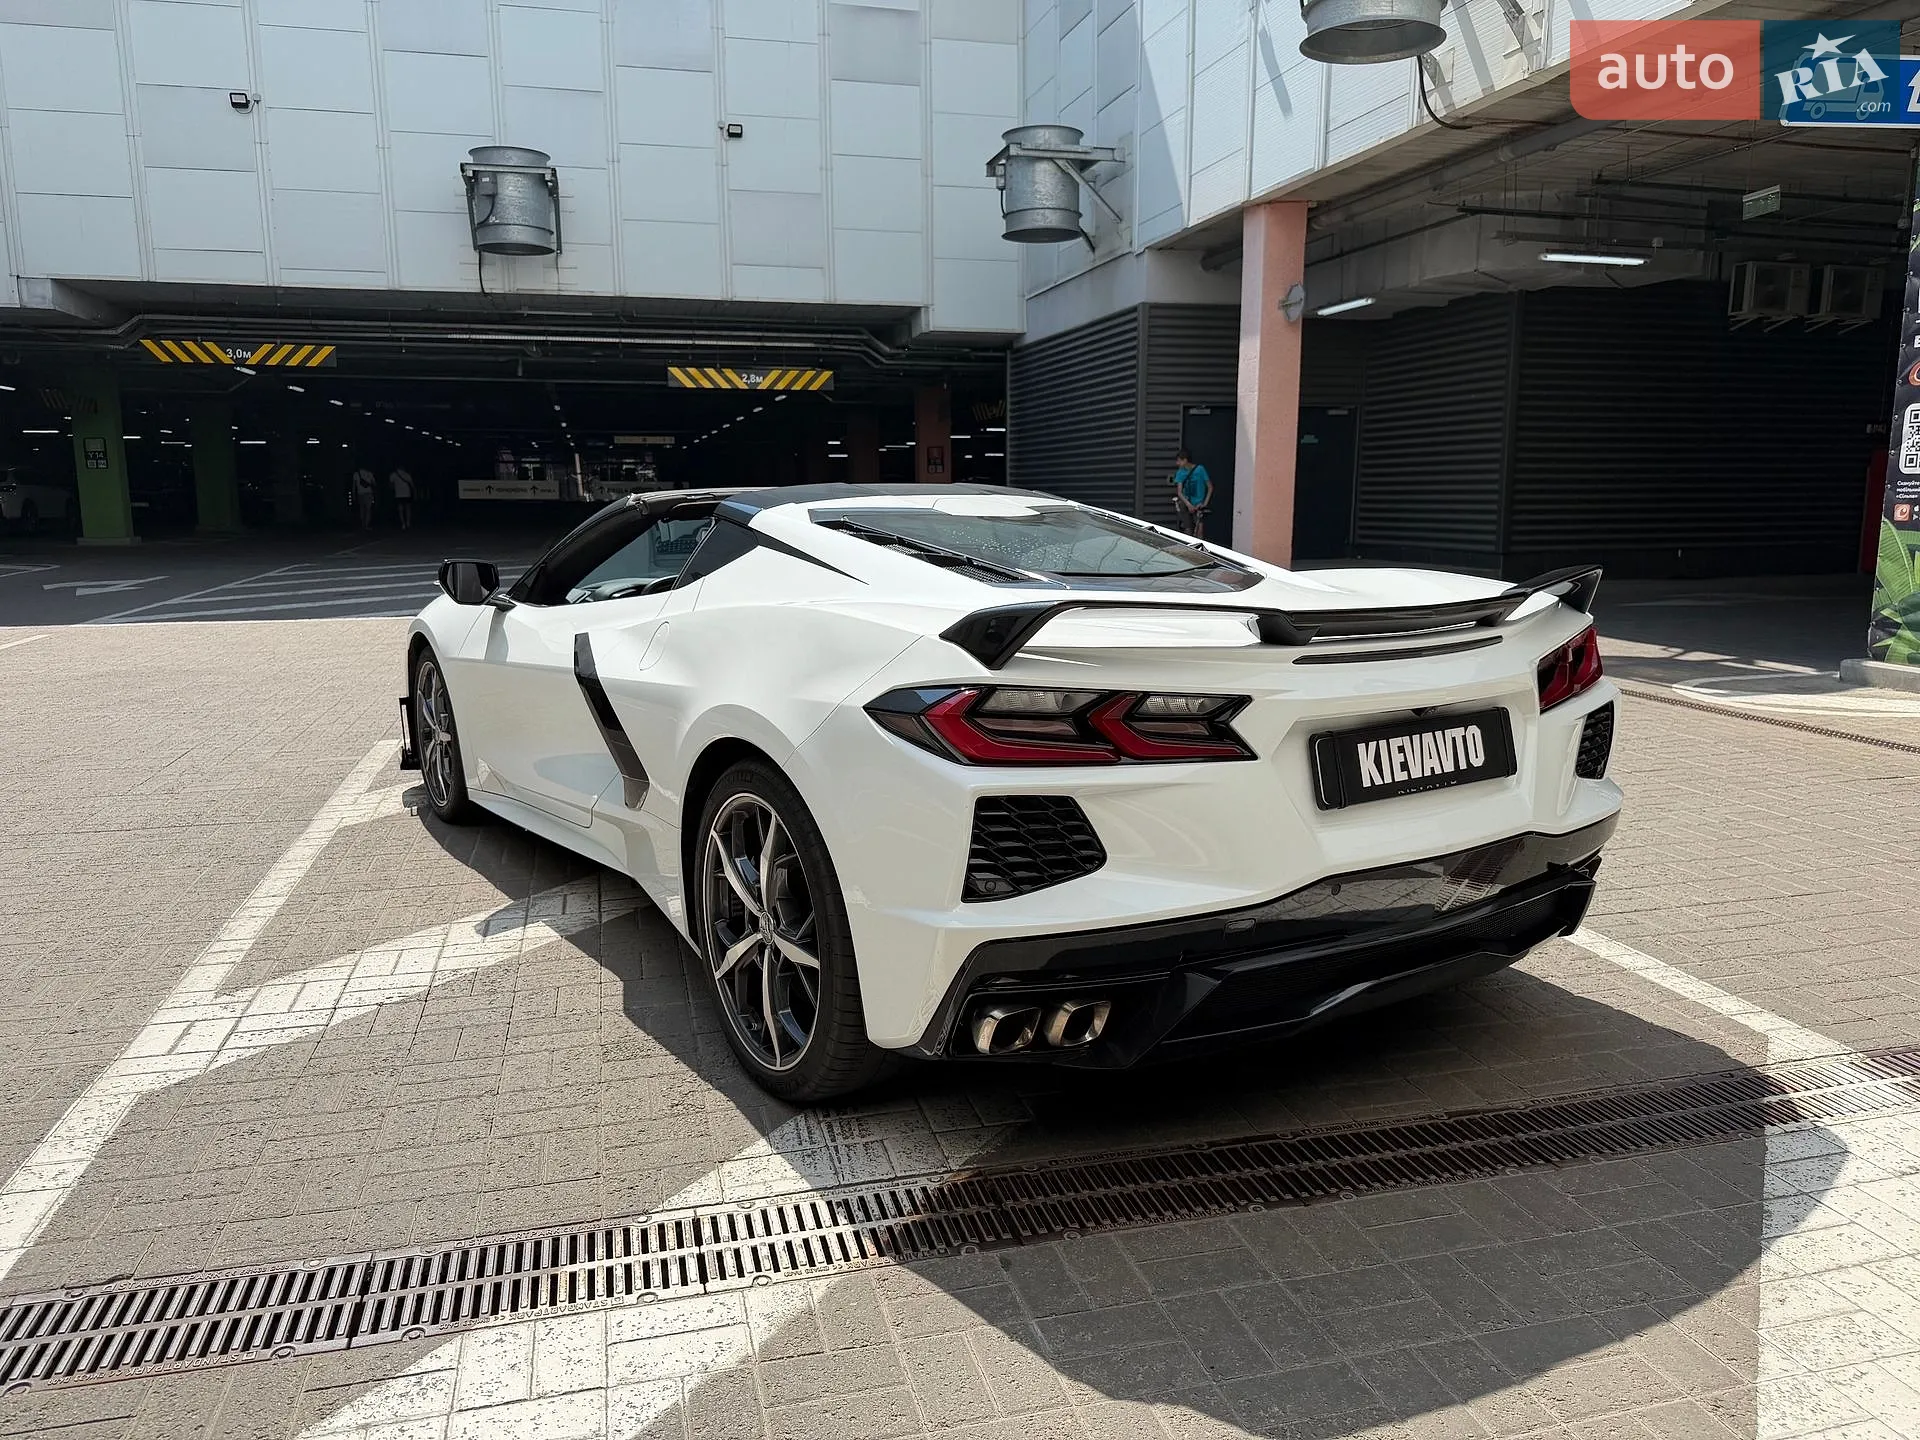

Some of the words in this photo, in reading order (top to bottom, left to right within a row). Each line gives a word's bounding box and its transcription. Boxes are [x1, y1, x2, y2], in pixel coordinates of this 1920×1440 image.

[1357, 724, 1485, 788] KIEVAVTO
[469, 1229, 559, 1246] STANDARTPARK
[118, 1271, 220, 1291] STANDARTPARK
[509, 1299, 607, 1320] STANDARTPARK
[126, 1353, 238, 1376] STANDARTPARK
